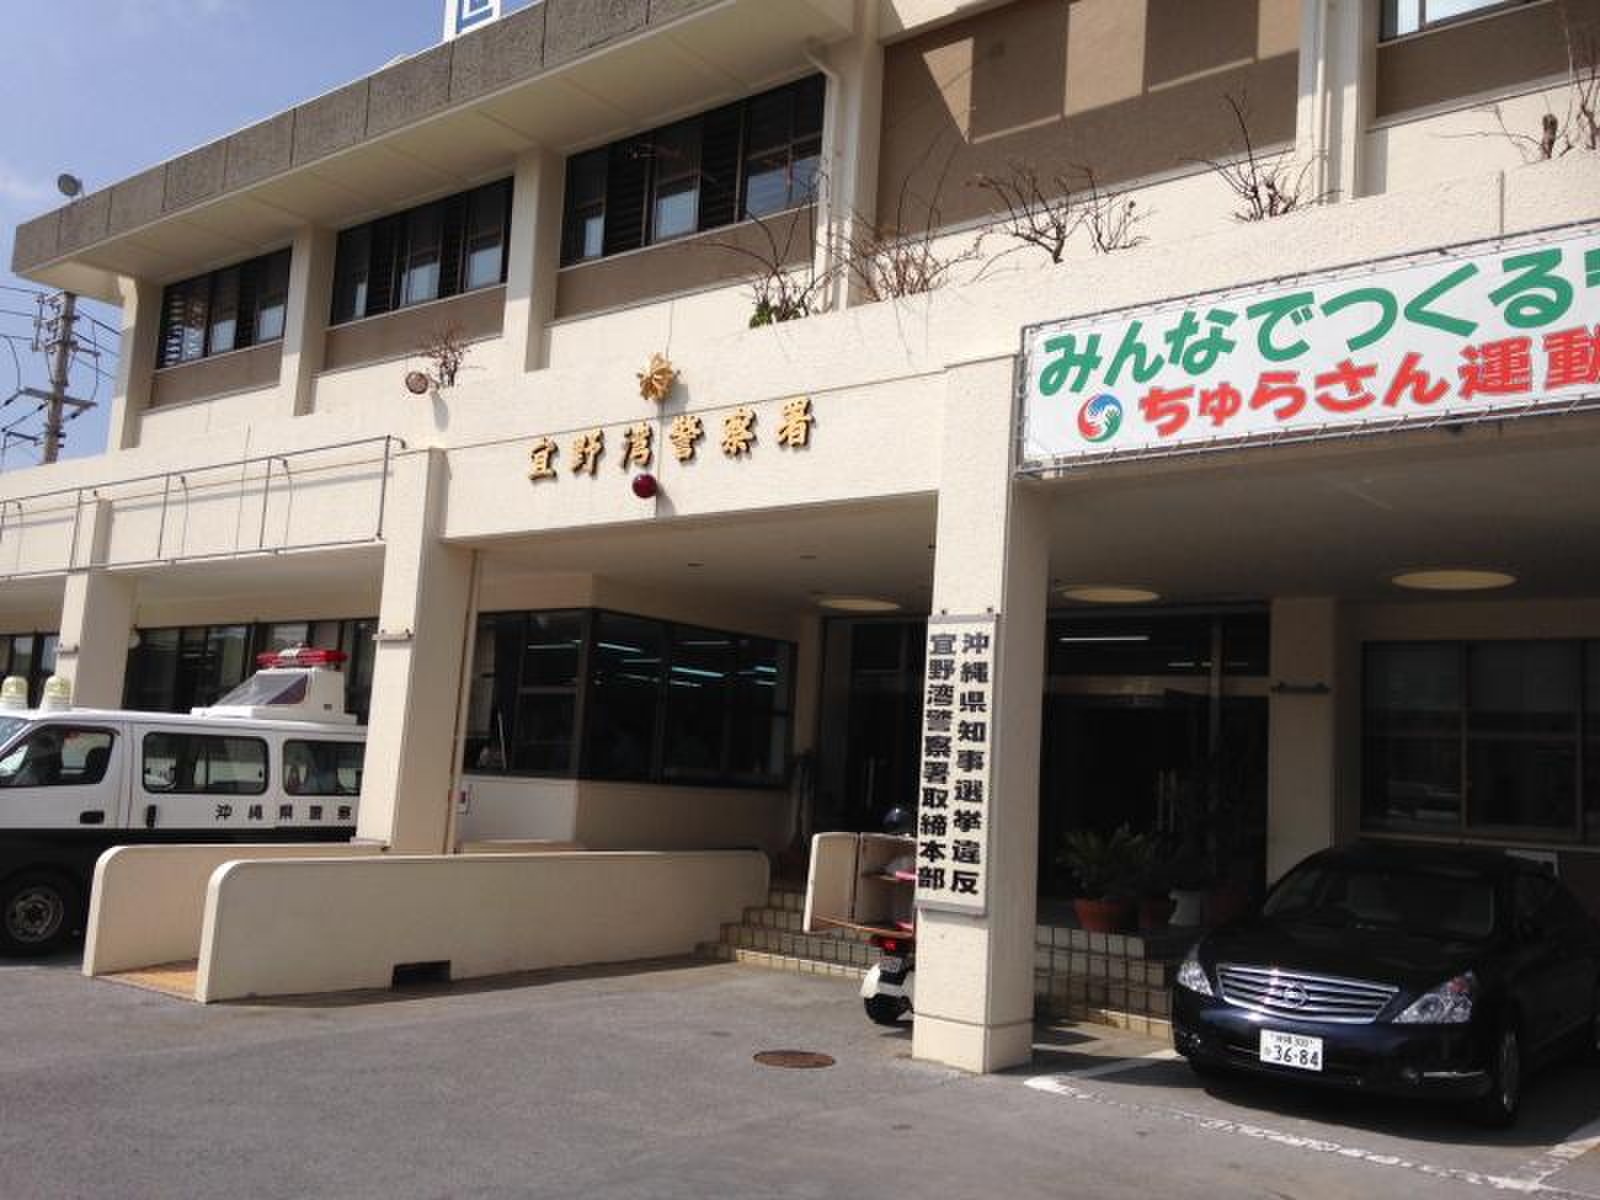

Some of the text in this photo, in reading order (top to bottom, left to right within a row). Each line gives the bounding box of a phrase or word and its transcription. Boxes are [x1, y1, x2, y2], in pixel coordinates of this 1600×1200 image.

[1039, 248, 1600, 396] みんなでつくる
[917, 633, 956, 891] 宜野湾警察署取締本部
[951, 632, 989, 894] 沖縄県知事選挙違反
